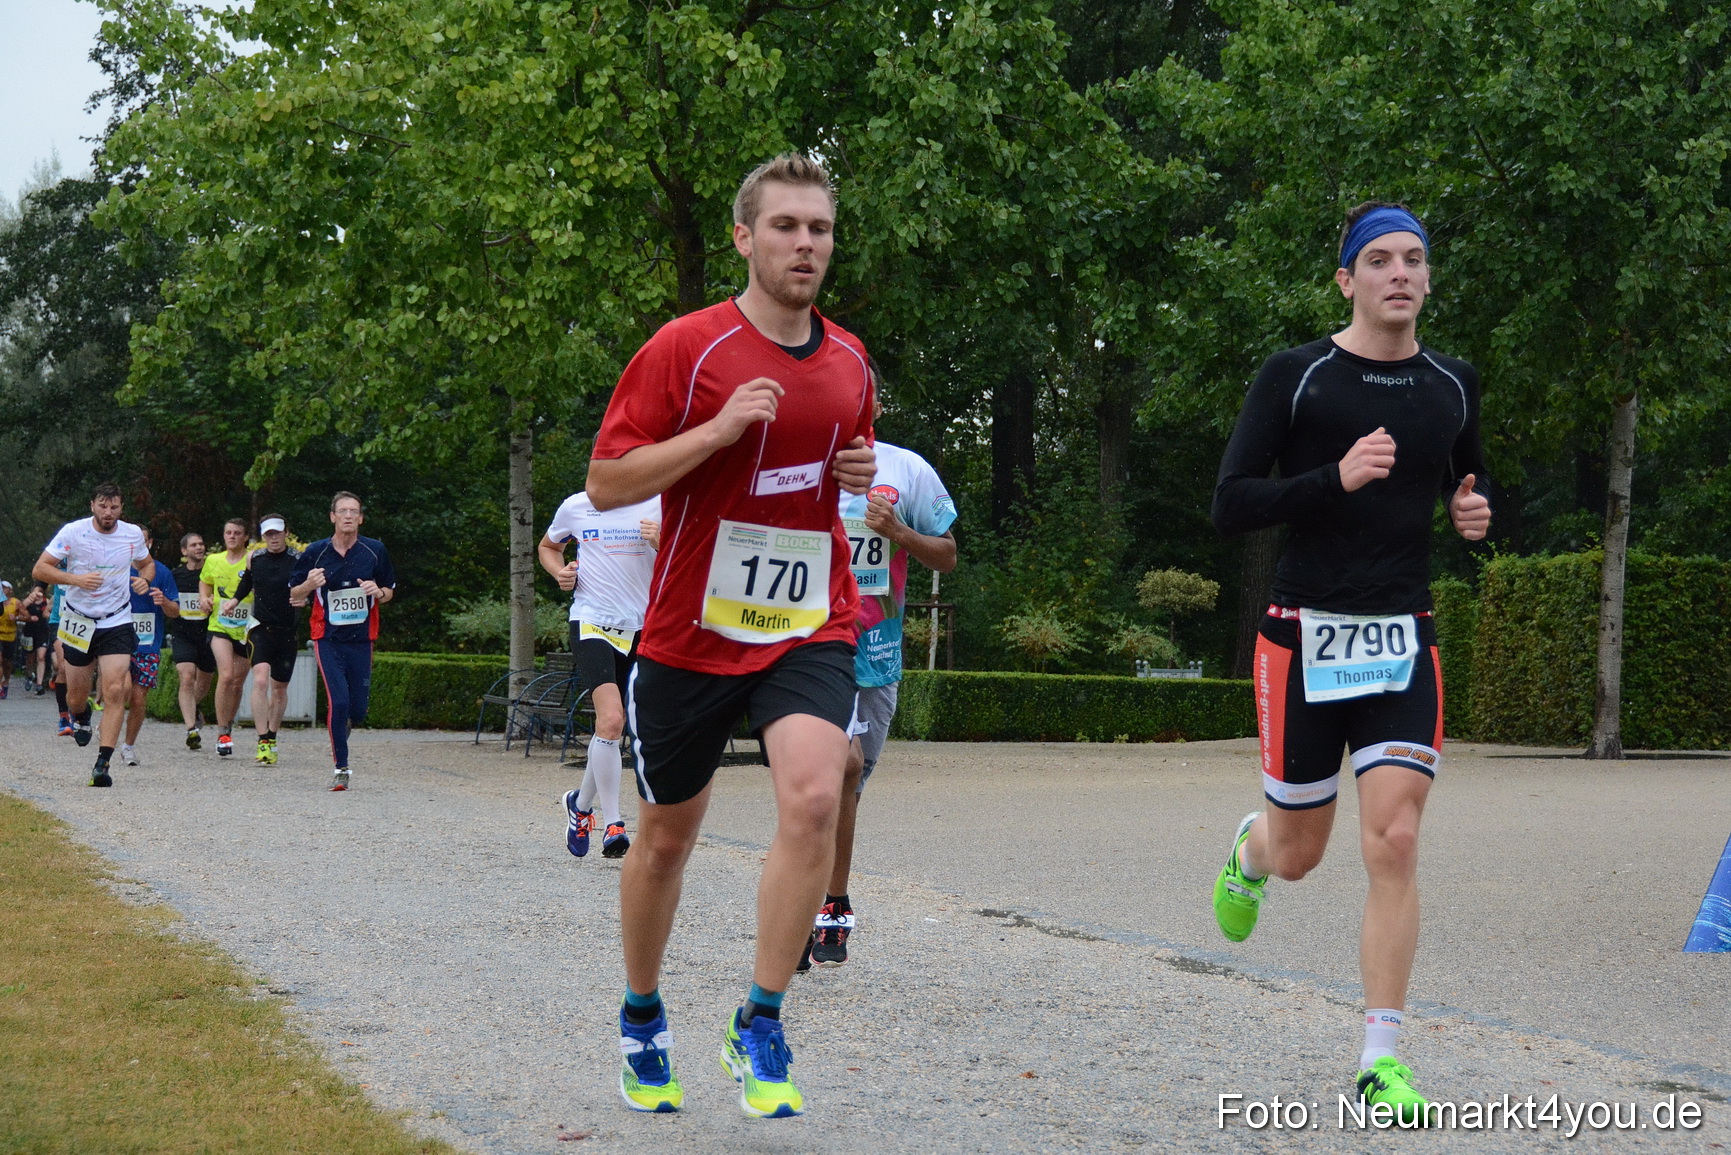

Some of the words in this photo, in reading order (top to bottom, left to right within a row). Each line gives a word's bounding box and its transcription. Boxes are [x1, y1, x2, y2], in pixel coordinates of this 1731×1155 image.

[1362, 373, 1414, 387] uhlsport
[777, 473, 807, 486] DEHN
[728, 536, 768, 548] NeuerMarkt
[775, 534, 821, 551] BOCK
[849, 537, 882, 565] 78
[741, 555, 808, 603] 170
[853, 573, 877, 585] asit
[333, 596, 364, 612] 2580
[741, 609, 791, 629] Martin
[64, 619, 87, 638] 112
[867, 629, 883, 644] 17.
[1315, 623, 1407, 661] 2790
[866, 649, 894, 662] Stadtlauf
[1333, 667, 1393, 685] Thomas
[1260, 653, 1271, 769] arndt-gruppe.de
[1410, 749, 1437, 766] SPORTS
